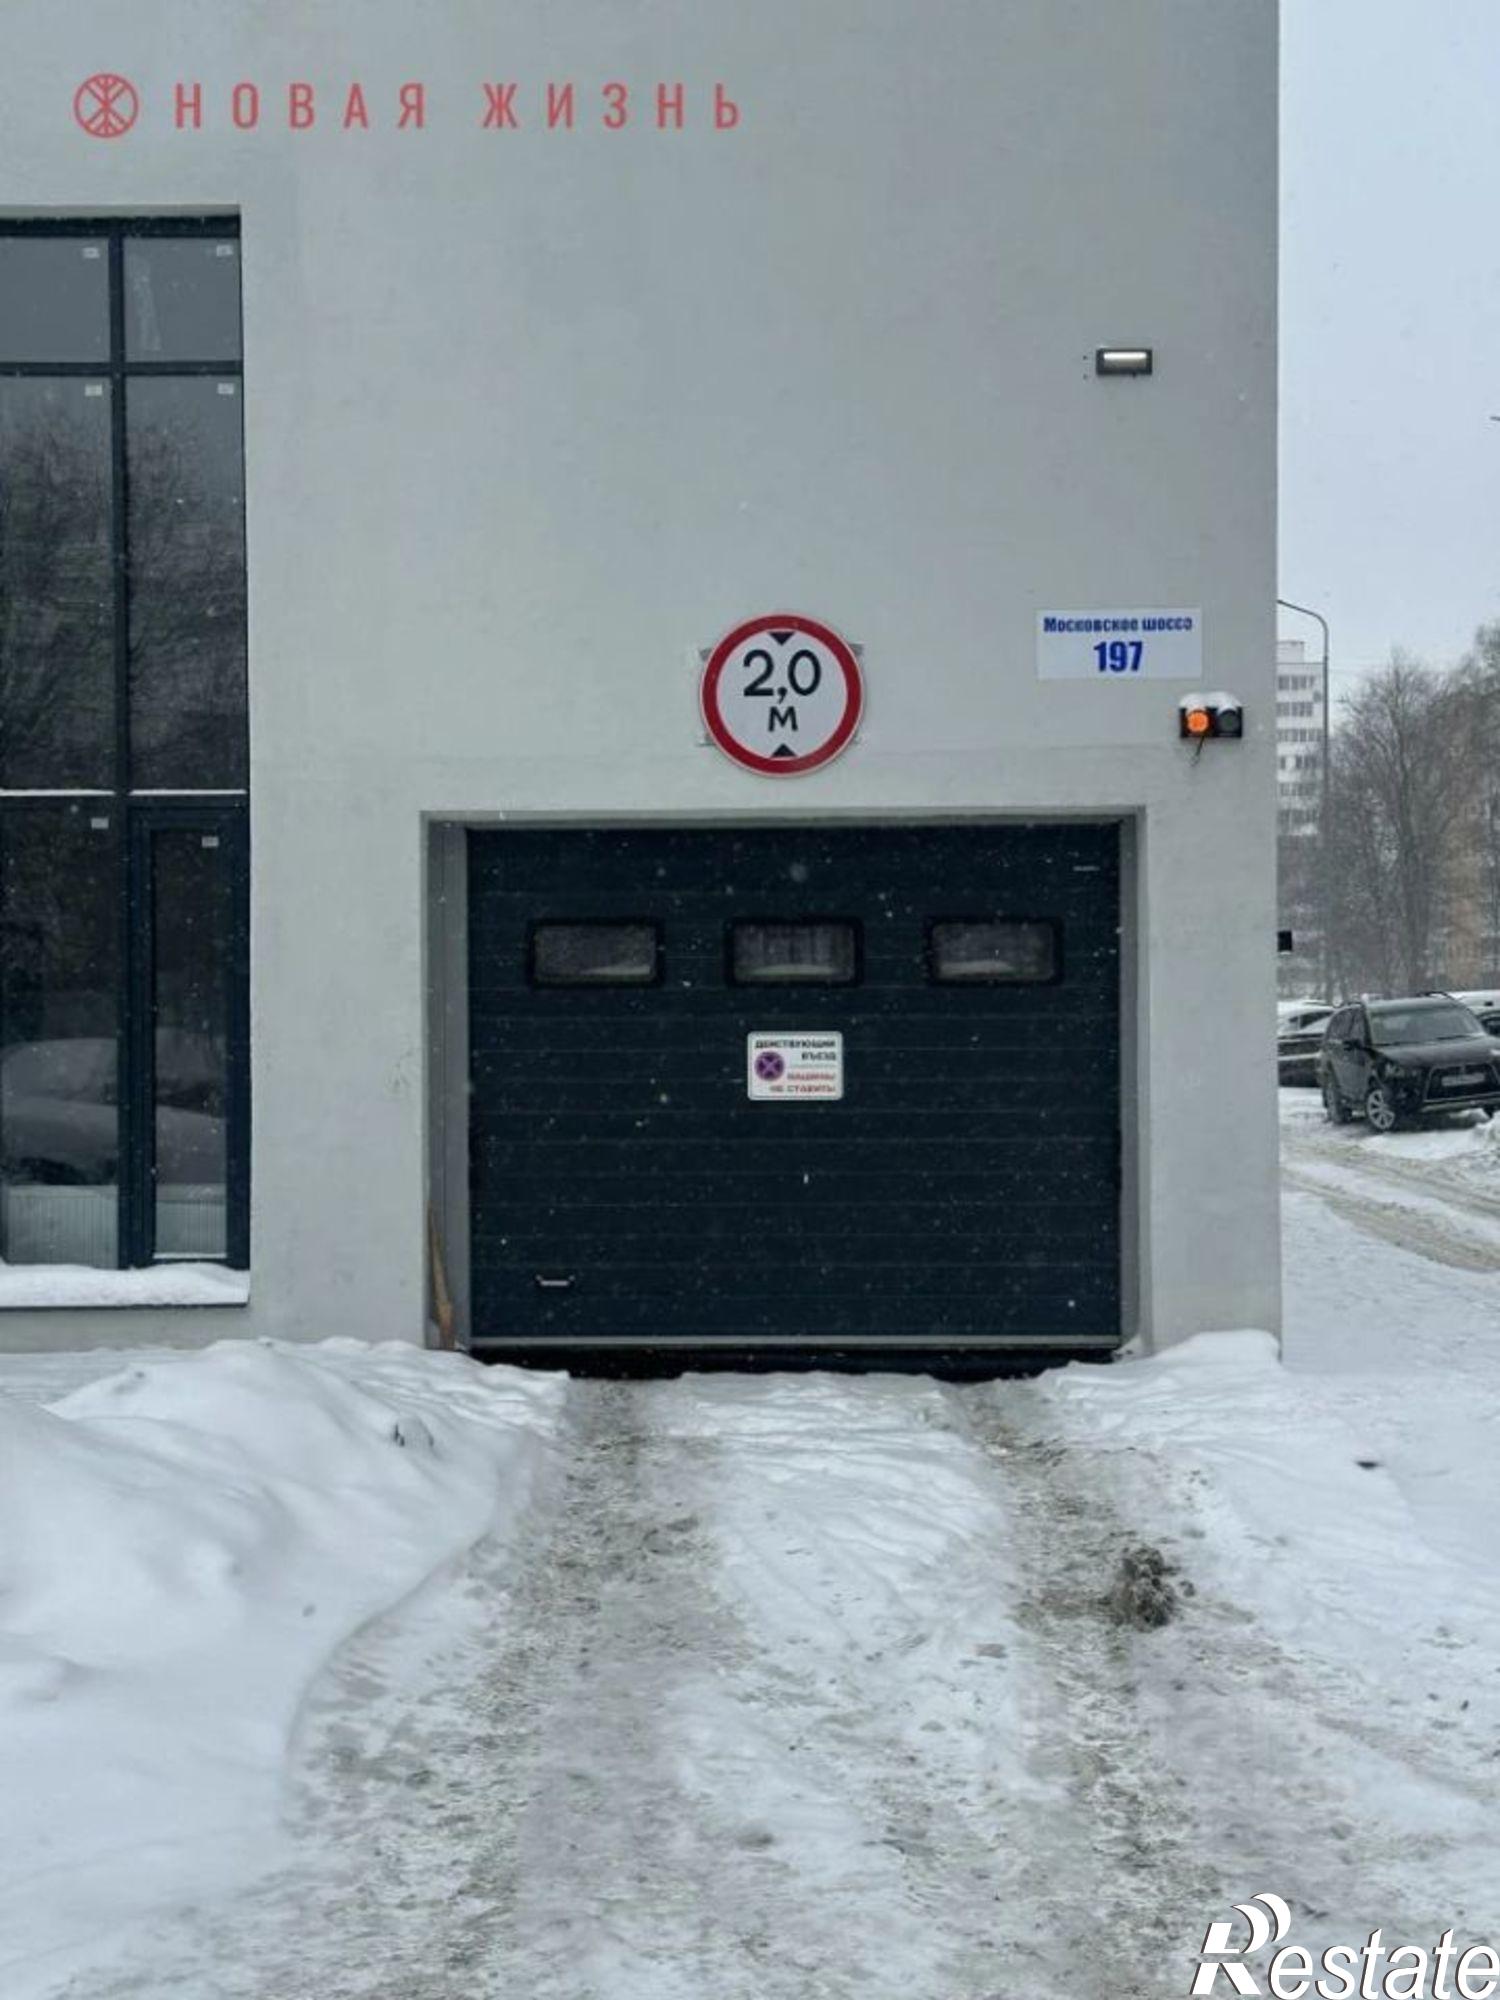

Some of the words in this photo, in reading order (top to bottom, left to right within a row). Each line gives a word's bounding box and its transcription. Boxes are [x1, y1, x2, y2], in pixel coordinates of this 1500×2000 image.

[173, 83, 425, 129] НОВАЯ
[481, 83, 740, 129] ЖИЗНЬ
[1043, 617, 1138, 632] Московское
[1093, 641, 1143, 672] 197
[743, 649, 821, 704] 2,0
